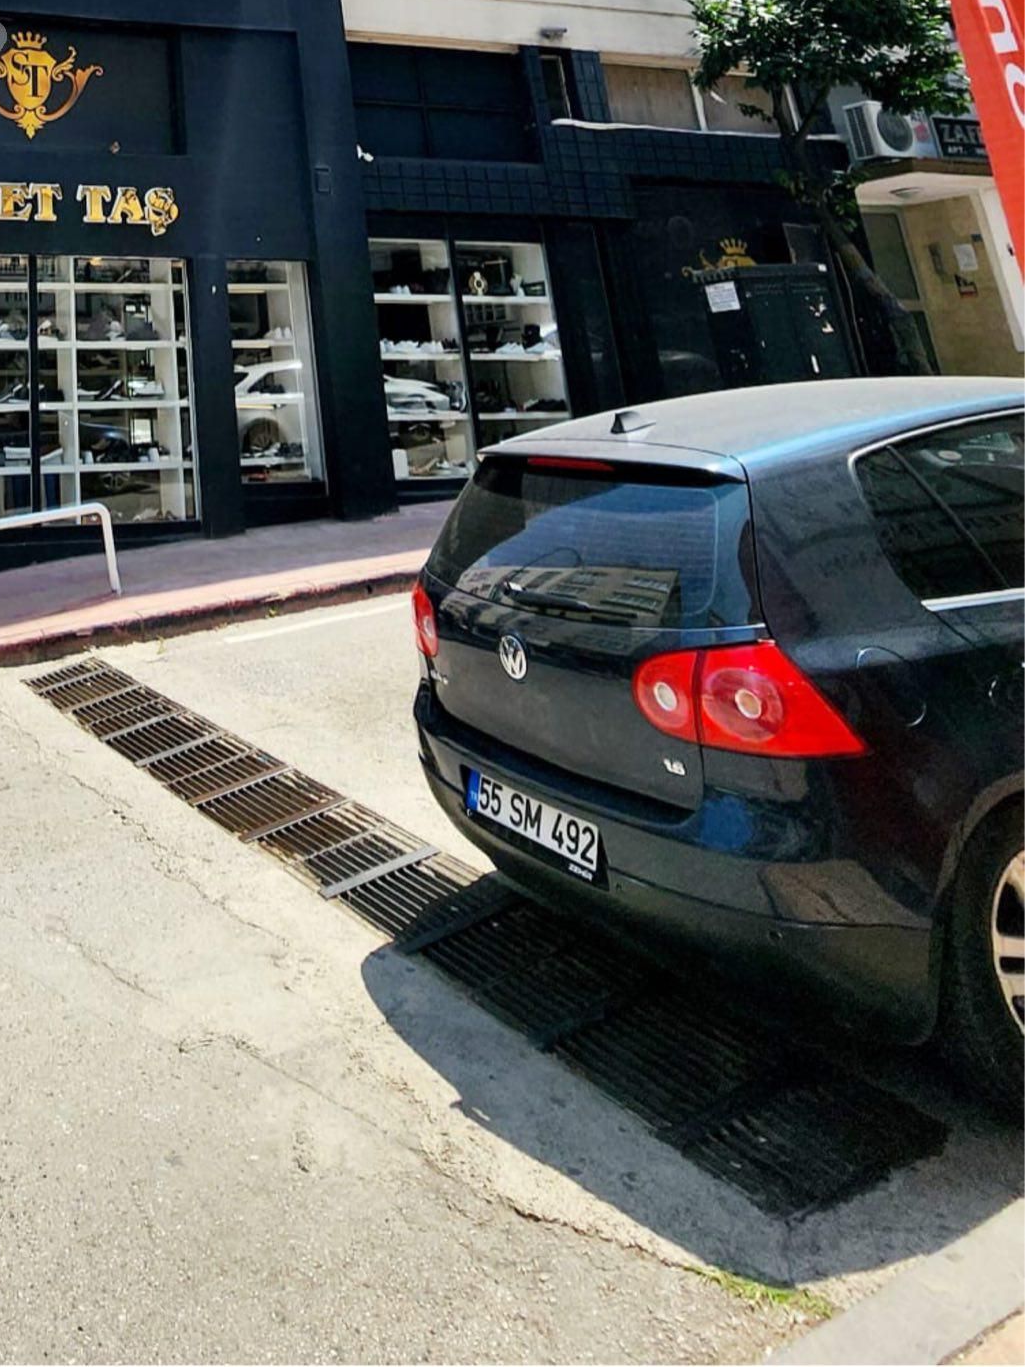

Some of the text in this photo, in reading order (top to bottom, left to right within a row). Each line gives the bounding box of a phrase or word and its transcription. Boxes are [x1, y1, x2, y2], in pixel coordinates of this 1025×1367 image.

[76, 184, 179, 236] TAŞ
[479, 777, 595, 865] 55 SM 492
